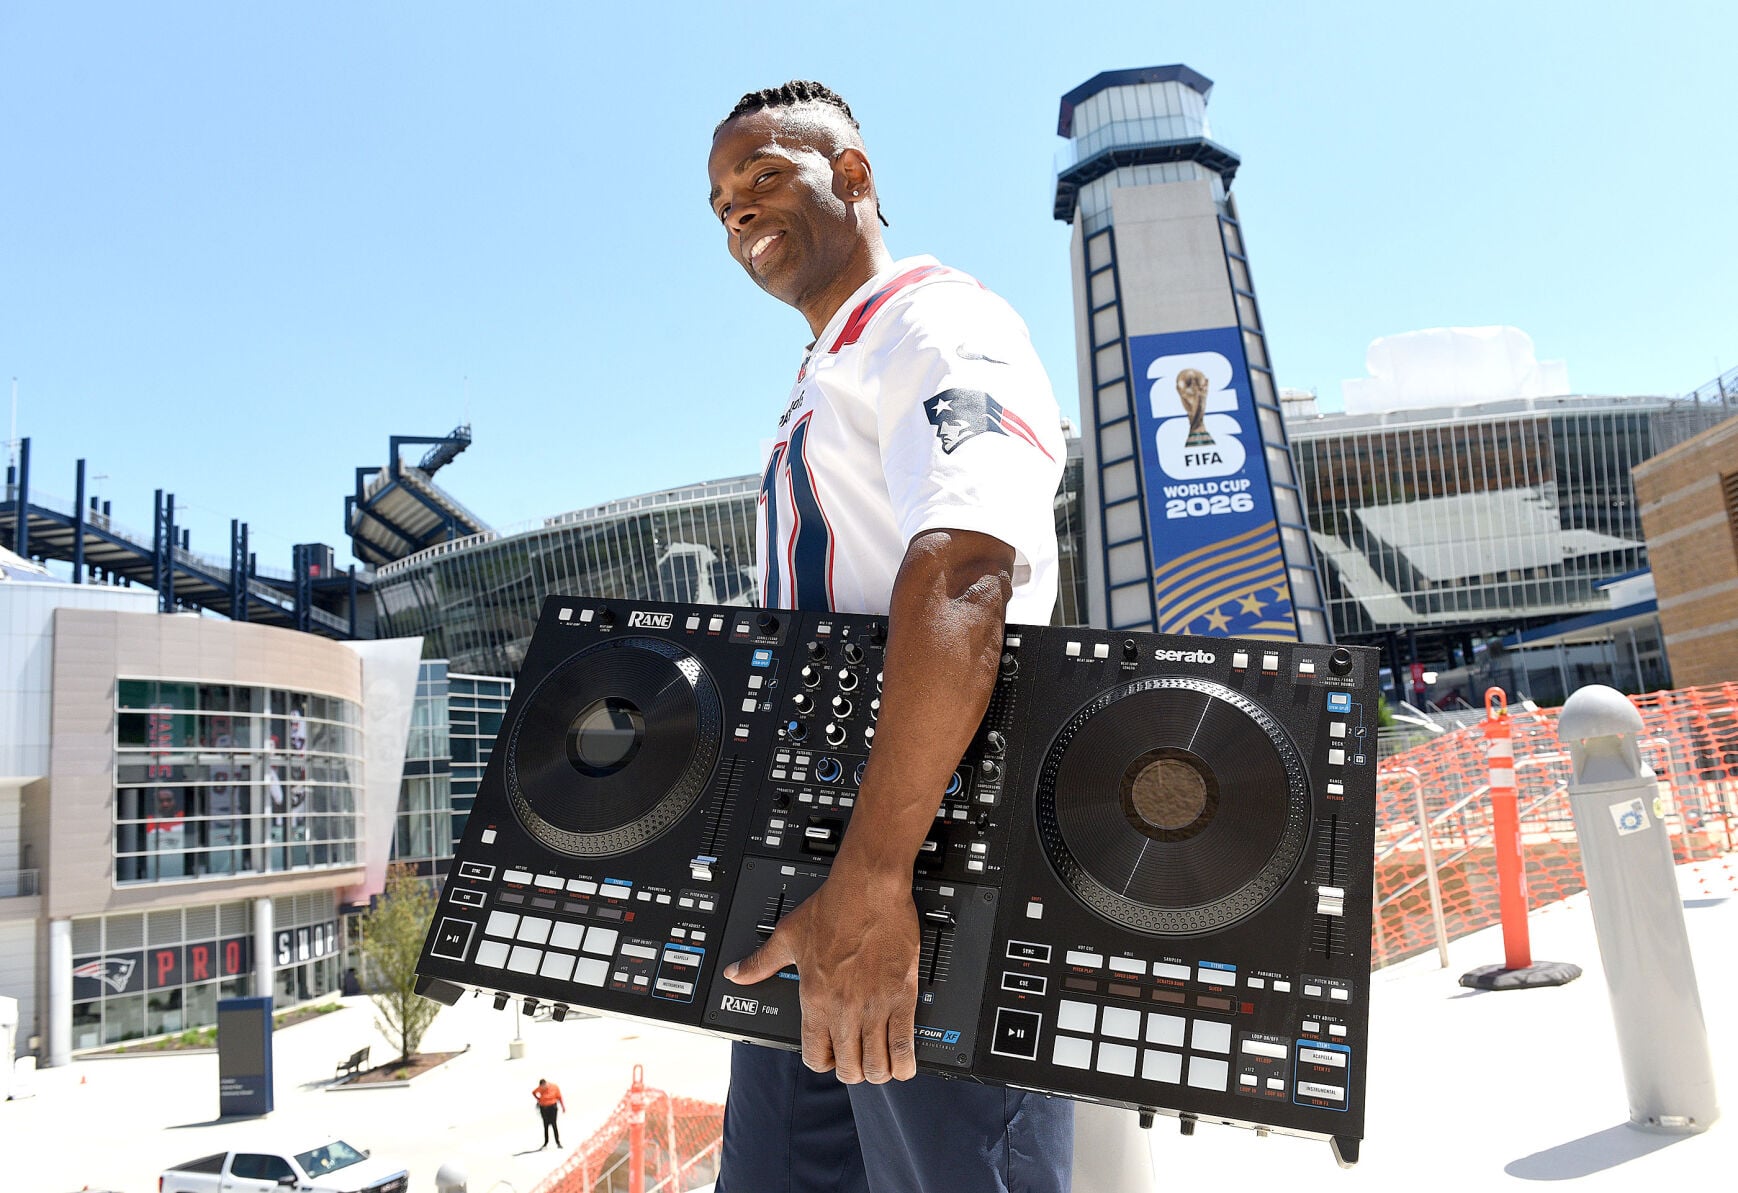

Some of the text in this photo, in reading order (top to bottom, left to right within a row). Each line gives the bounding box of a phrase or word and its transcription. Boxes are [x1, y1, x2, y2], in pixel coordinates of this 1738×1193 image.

[1185, 452, 1223, 466] FIFA
[1164, 479, 1250, 498] WORLD CUP
[1166, 493, 1254, 519] 2026
[628, 611, 673, 629] RANE
[1155, 649, 1216, 664] serato
[156, 941, 239, 986] PRO
[720, 995, 778, 1015] RANE FOUR
[920, 1030, 942, 1038] FOUR
[1306, 1086, 1336, 1095] INSTRUMENTAL
